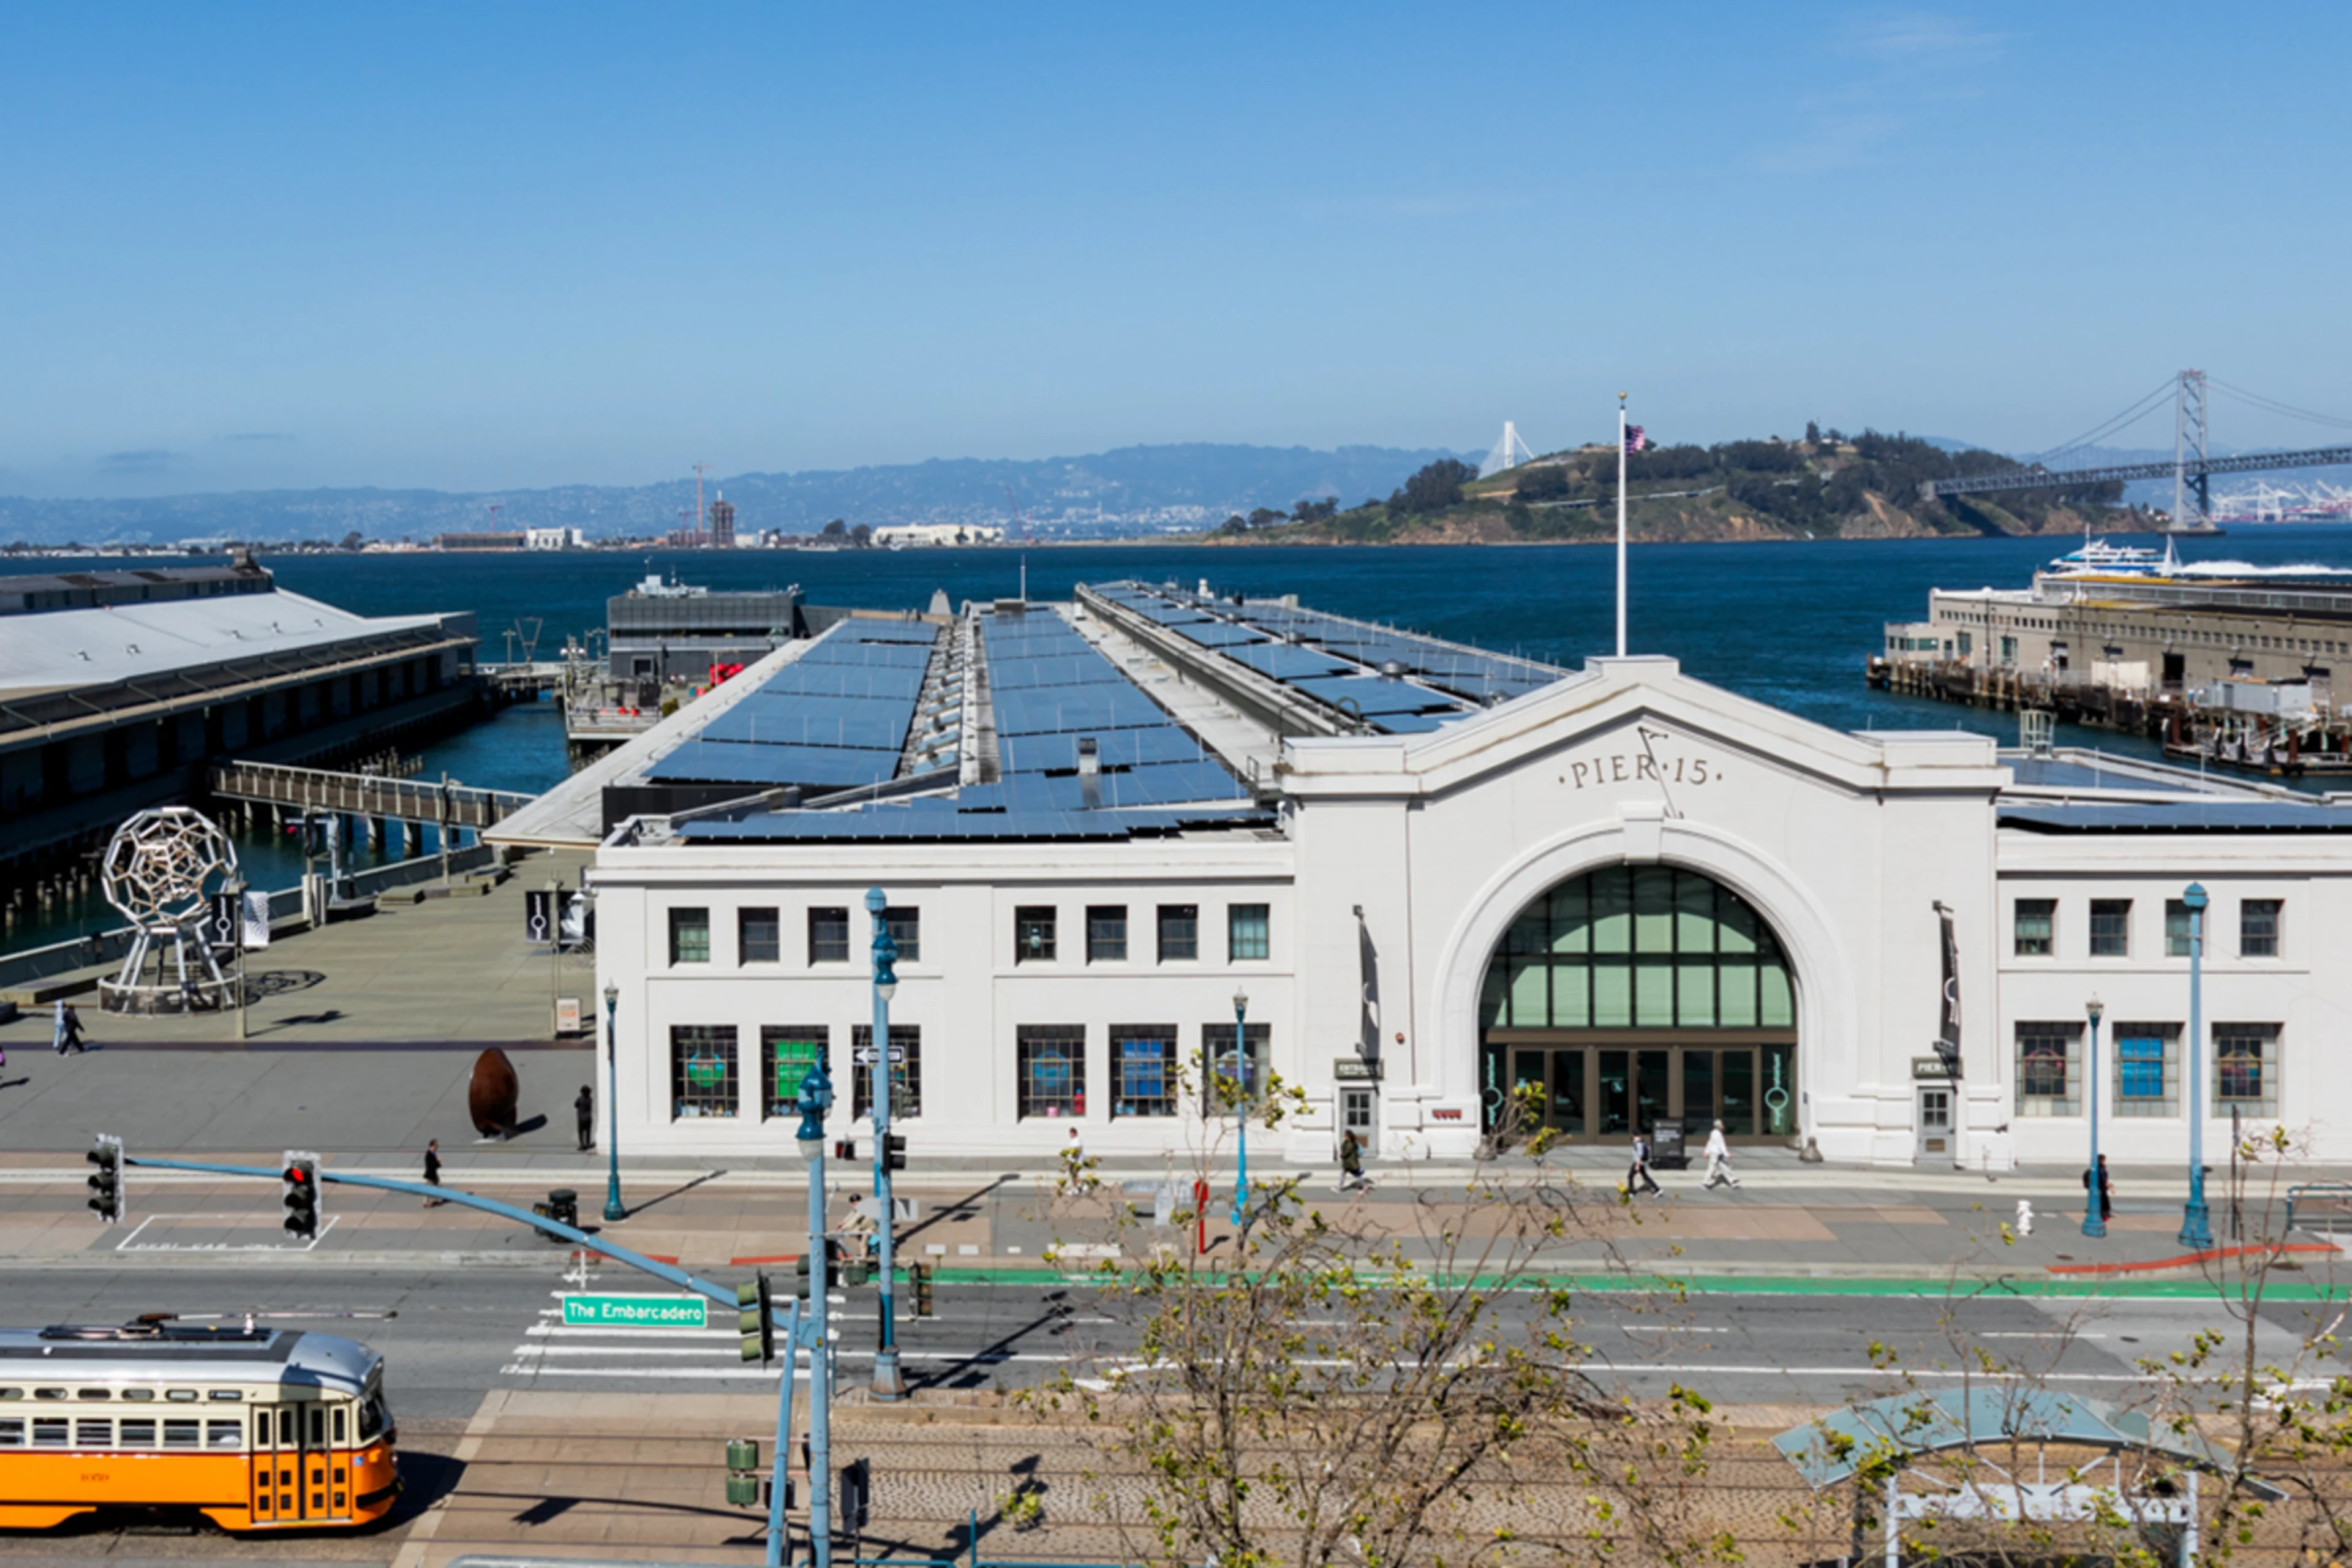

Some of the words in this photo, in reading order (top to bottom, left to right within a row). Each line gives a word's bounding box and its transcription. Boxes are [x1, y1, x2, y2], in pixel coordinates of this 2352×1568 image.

[1570, 753, 1659, 789] PIER
[568, 1302, 595, 1317] The
[601, 1303, 703, 1321] Embarcadero
